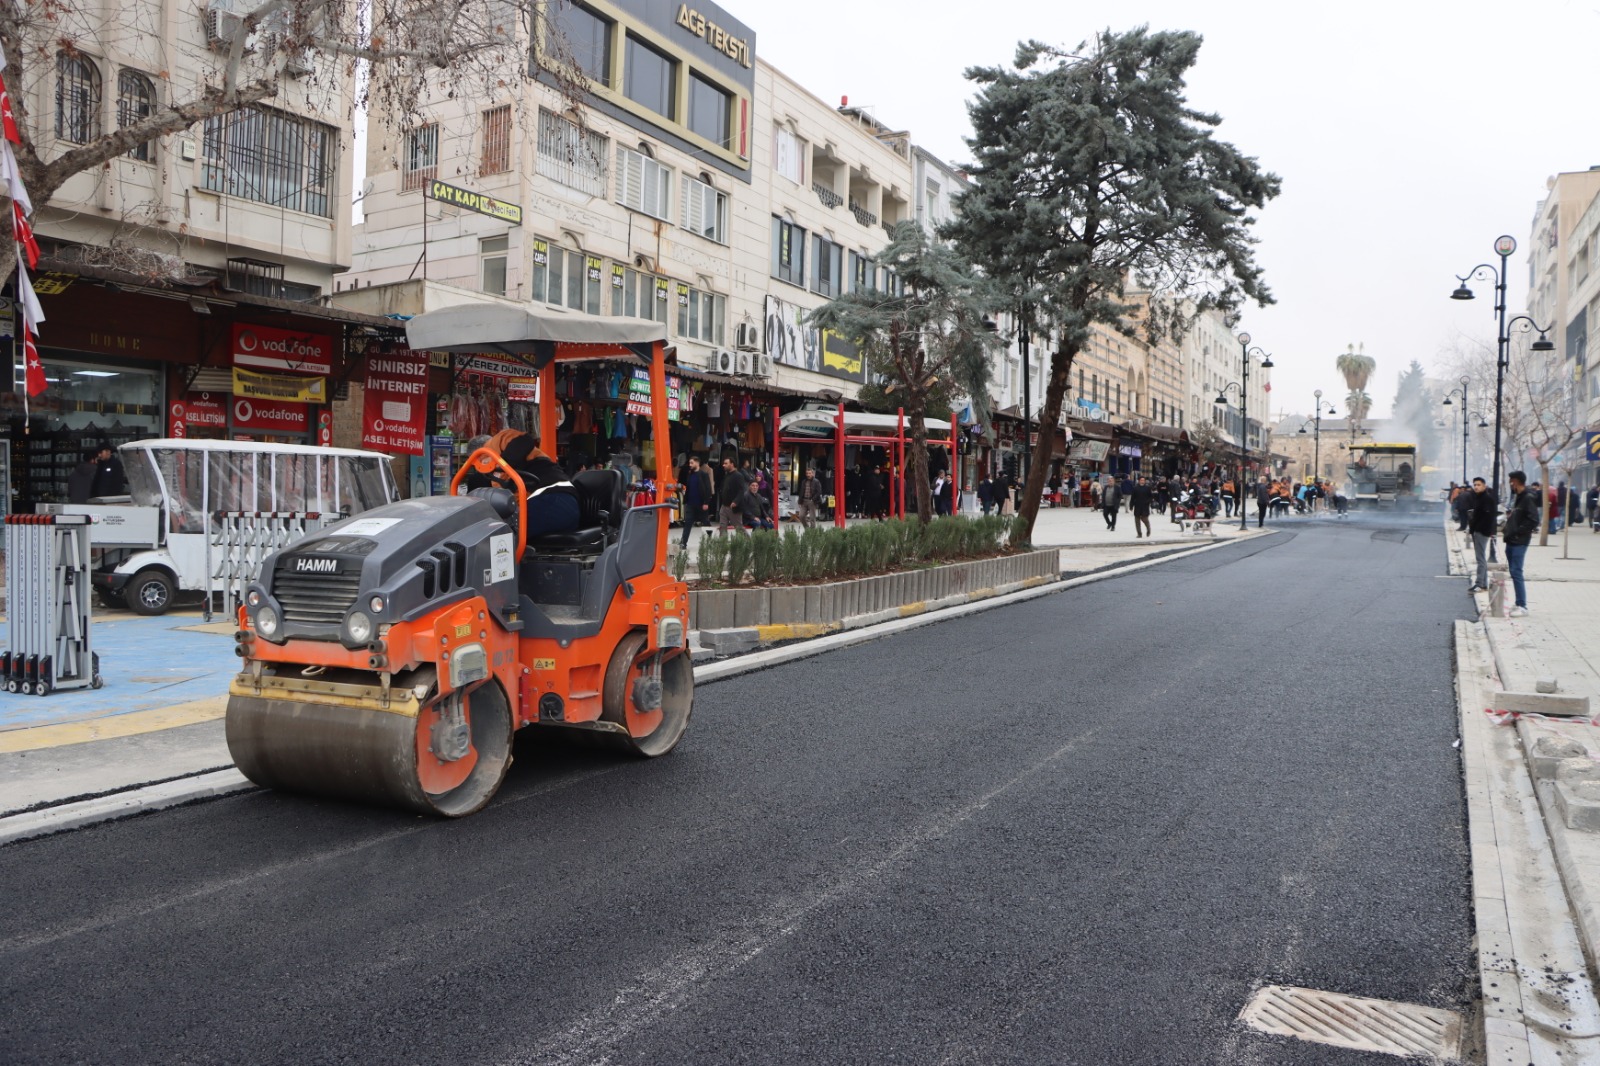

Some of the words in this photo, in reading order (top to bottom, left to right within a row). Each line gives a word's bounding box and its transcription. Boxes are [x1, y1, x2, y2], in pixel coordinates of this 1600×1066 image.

[706, 21, 752, 69] TEKSTİL
[433, 183, 453, 200] ÇAT
[455, 189, 480, 209] KAPI
[90, 332, 140, 350] HOME
[369, 358, 426, 375] SINIRSIZ
[367, 376, 426, 394] İNTERNET
[629, 392, 651, 404] GÖMLE
[186, 412, 200, 422] ASEL
[255, 408, 305, 422] vodafone
[173, 421, 184, 438] AS
[384, 424, 417, 435] vodafone
[363, 434, 387, 445] ASEL
[389, 435, 424, 450] İLETİŞİM
[296, 558, 338, 572] HAMM
